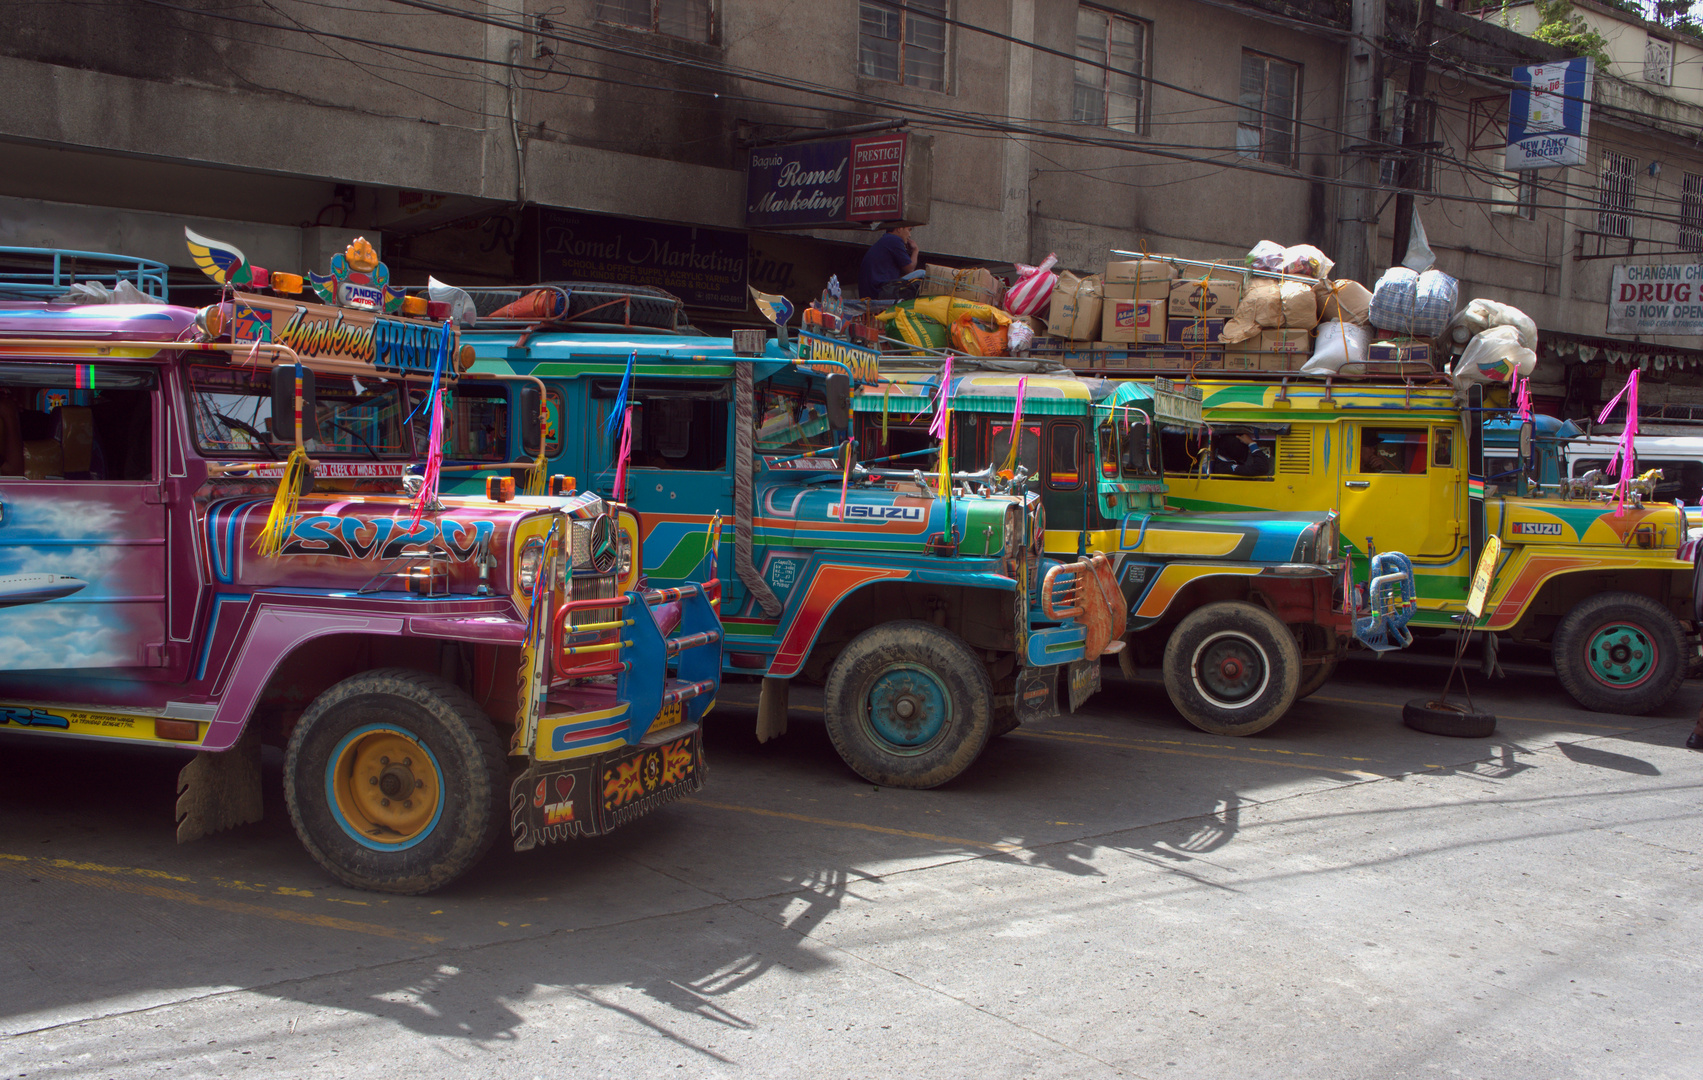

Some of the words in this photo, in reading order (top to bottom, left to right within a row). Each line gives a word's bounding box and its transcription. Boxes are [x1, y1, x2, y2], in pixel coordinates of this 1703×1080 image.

[1520, 140, 1539, 151] NEW
[1542, 137, 1569, 149] FANCY
[1525, 146, 1565, 158] GROCERY
[752, 153, 783, 170] Baguio
[856, 147, 900, 163] PRESTIGE
[777, 157, 848, 188] Romel
[855, 171, 898, 186] PAPER
[748, 189, 845, 217] Marketing
[853, 193, 897, 208] PRODUCTS
[545, 226, 622, 261] Romel
[627, 237, 745, 283] Marketing
[562, 259, 596, 271] SCHOOL
[608, 263, 636, 275] OFFICE
[670, 270, 703, 282] ACRYLIC
[705, 274, 730, 284] YARNS
[572, 268, 589, 278] ALL
[590, 270, 615, 281] KINDS
[617, 272, 628, 281] OF
[630, 274, 663, 286] PLASTIC
[665, 278, 687, 288] BAGS
[695, 281, 720, 291] ROLLS
[1628, 266, 1681, 280] CHANGAN
[345, 286, 383, 306] ZANDER
[1618, 283, 1692, 302] DRUG
[1625, 305, 1637, 318] IS
[1639, 305, 1670, 318] NOW
[273, 305, 378, 361] Answered
[845, 505, 920, 520] ISUZU
[1522, 523, 1562, 535] ISUZU
